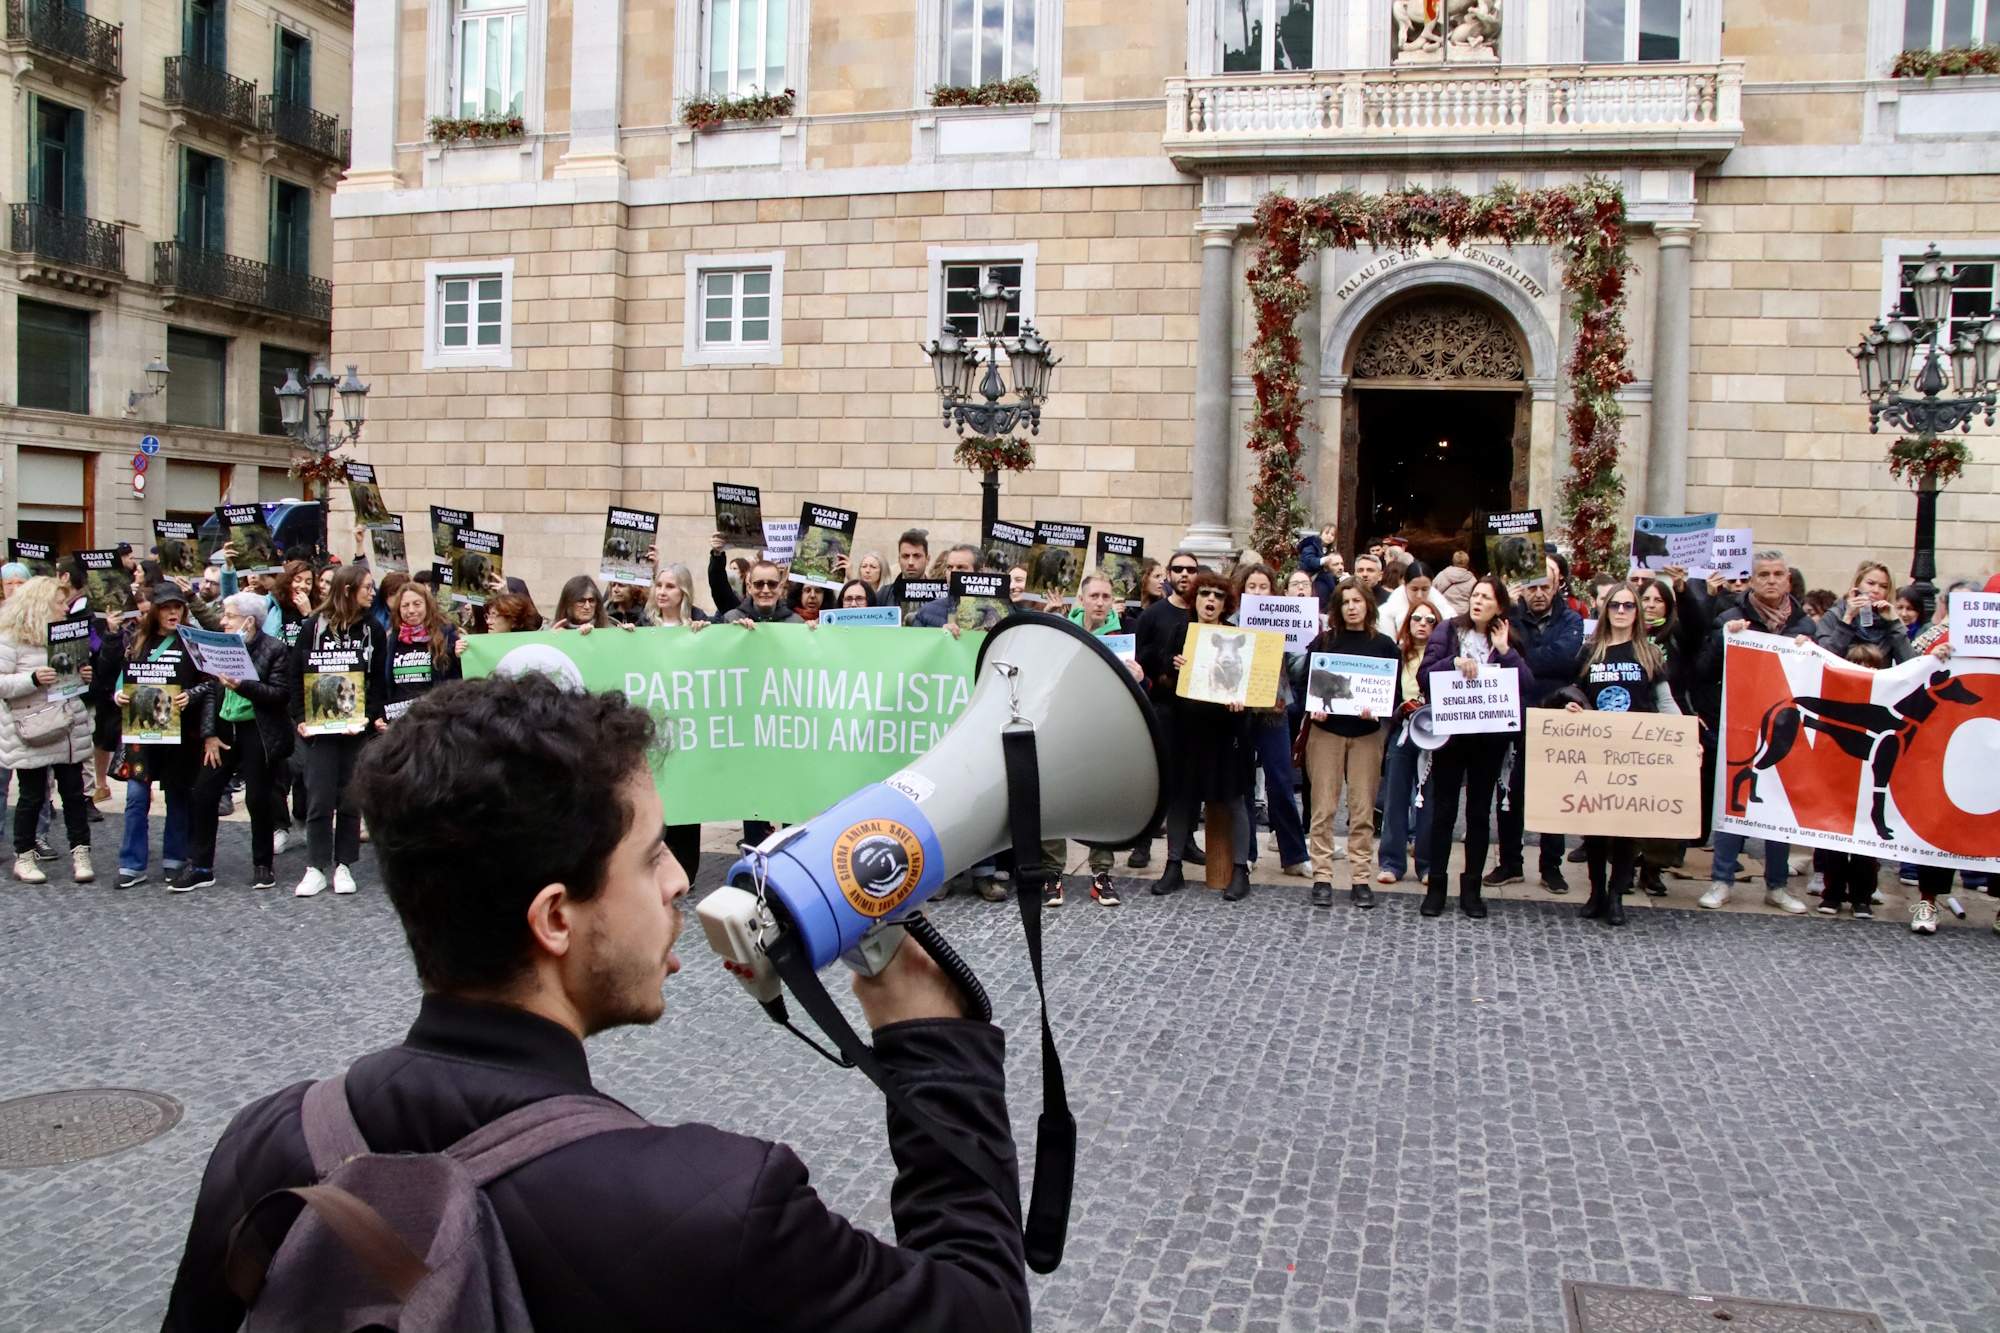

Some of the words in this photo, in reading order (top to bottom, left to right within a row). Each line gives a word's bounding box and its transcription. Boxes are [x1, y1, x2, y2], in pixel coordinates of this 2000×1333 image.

[1337, 264, 1376, 300] PALAU
[1379, 254, 1398, 270] DE
[1401, 247, 1420, 261] LA
[1462, 247, 1545, 299] GENERALITAT
[717, 485, 747, 496] MERECEN
[747, 489, 756, 497] SU
[717, 493, 741, 502] PROPIA
[741, 496, 757, 505] VIDA
[224, 508, 246, 516] CAZAR
[437, 509, 458, 518] CAZAR
[612, 510, 644, 521] MERECEN
[645, 515, 655, 523] SU
[811, 507, 838, 519] CAZAR
[839, 513, 850, 521] ES
[1511, 512, 1535, 520] PAGAN
[230, 515, 254, 523] MATAR
[441, 516, 463, 525] MATAR
[610, 518, 637, 528] PROPIA
[637, 521, 655, 530] VIDA
[814, 516, 843, 530] MATAR
[1503, 519, 1537, 527] NUESTROS
[993, 522, 1024, 536] MERECEN
[1025, 530, 1034, 538] SU
[1042, 523, 1062, 532] ELLOS
[1062, 526, 1085, 534] PAGAN
[459, 529, 477, 537] ELLOS
[477, 532, 498, 541] PAGAN
[991, 529, 1017, 541] PROPIA
[1017, 536, 1033, 547] VIDA
[1052, 531, 1085, 540] NUESTROS
[16, 542, 40, 550] CAZAR
[469, 537, 500, 548] NUESTROS
[1046, 538, 1075, 547] ERRORES
[1104, 535, 1127, 545] CAZAR
[1128, 539, 1137, 547] ES
[20, 549, 45, 559] MATAR
[1108, 544, 1133, 554] MATAR
[1729, 548, 1747, 556] DELS
[87, 560, 113, 568] MATAR
[960, 576, 989, 585] CAZAR
[991, 578, 1002, 586] ES
[905, 583, 941, 591] MERECEN
[965, 585, 996, 595] MATAR
[1259, 603, 1302, 614] CAÇADORS,
[1963, 601, 1980, 610] ELS
[51, 621, 80, 633] MERECEN
[80, 620, 89, 628] SU
[1292, 619, 1301, 628] DE
[1303, 620, 1313, 629] LA
[51, 630, 74, 641] PROPIA
[1728, 637, 1763, 649] Organitza
[323, 657, 359, 665] NUESTROS
[1606, 662, 1641, 671] PLANET.
[1360, 677, 1391, 686] MENOS
[1590, 672, 1619, 683] THEIRS
[1621, 671, 1641, 681] TOO!
[1452, 681, 1463, 689] NO
[1484, 679, 1498, 687] ELS
[625, 667, 750, 710] PARTIT
[760, 667, 970, 715] ANIMALISTA
[1355, 686, 1383, 695] BALAS
[1442, 695, 1486, 706] SENGLARS,
[1499, 694, 1509, 703] LA
[1478, 709, 1518, 720] CRIMINAL.
[710, 715, 745, 749] EL
[754, 714, 818, 751] MEDI
[1545, 748, 1587, 764] PARA
[1603, 749, 1674, 765] PROTEGER
[1574, 769, 1588, 785] A
[1607, 771, 1638, 786] LOS
[1560, 794, 1684, 815] SANTUARIOS
[1736, 818, 1776, 831] indefensa
[1800, 829, 1816, 837] una
[1818, 832, 1856, 844] criatura,
[1858, 838, 1877, 847] més
[1880, 842, 1898, 850] dret
[836, 845, 851, 881] GIRONA
[845, 822, 883, 843] ANIMAL
[889, 823, 913, 844] SAVE
[848, 889, 875, 912] ANIMAL
[878, 899, 896, 912] SAVE
[896, 851, 921, 899] MOVEMENT
